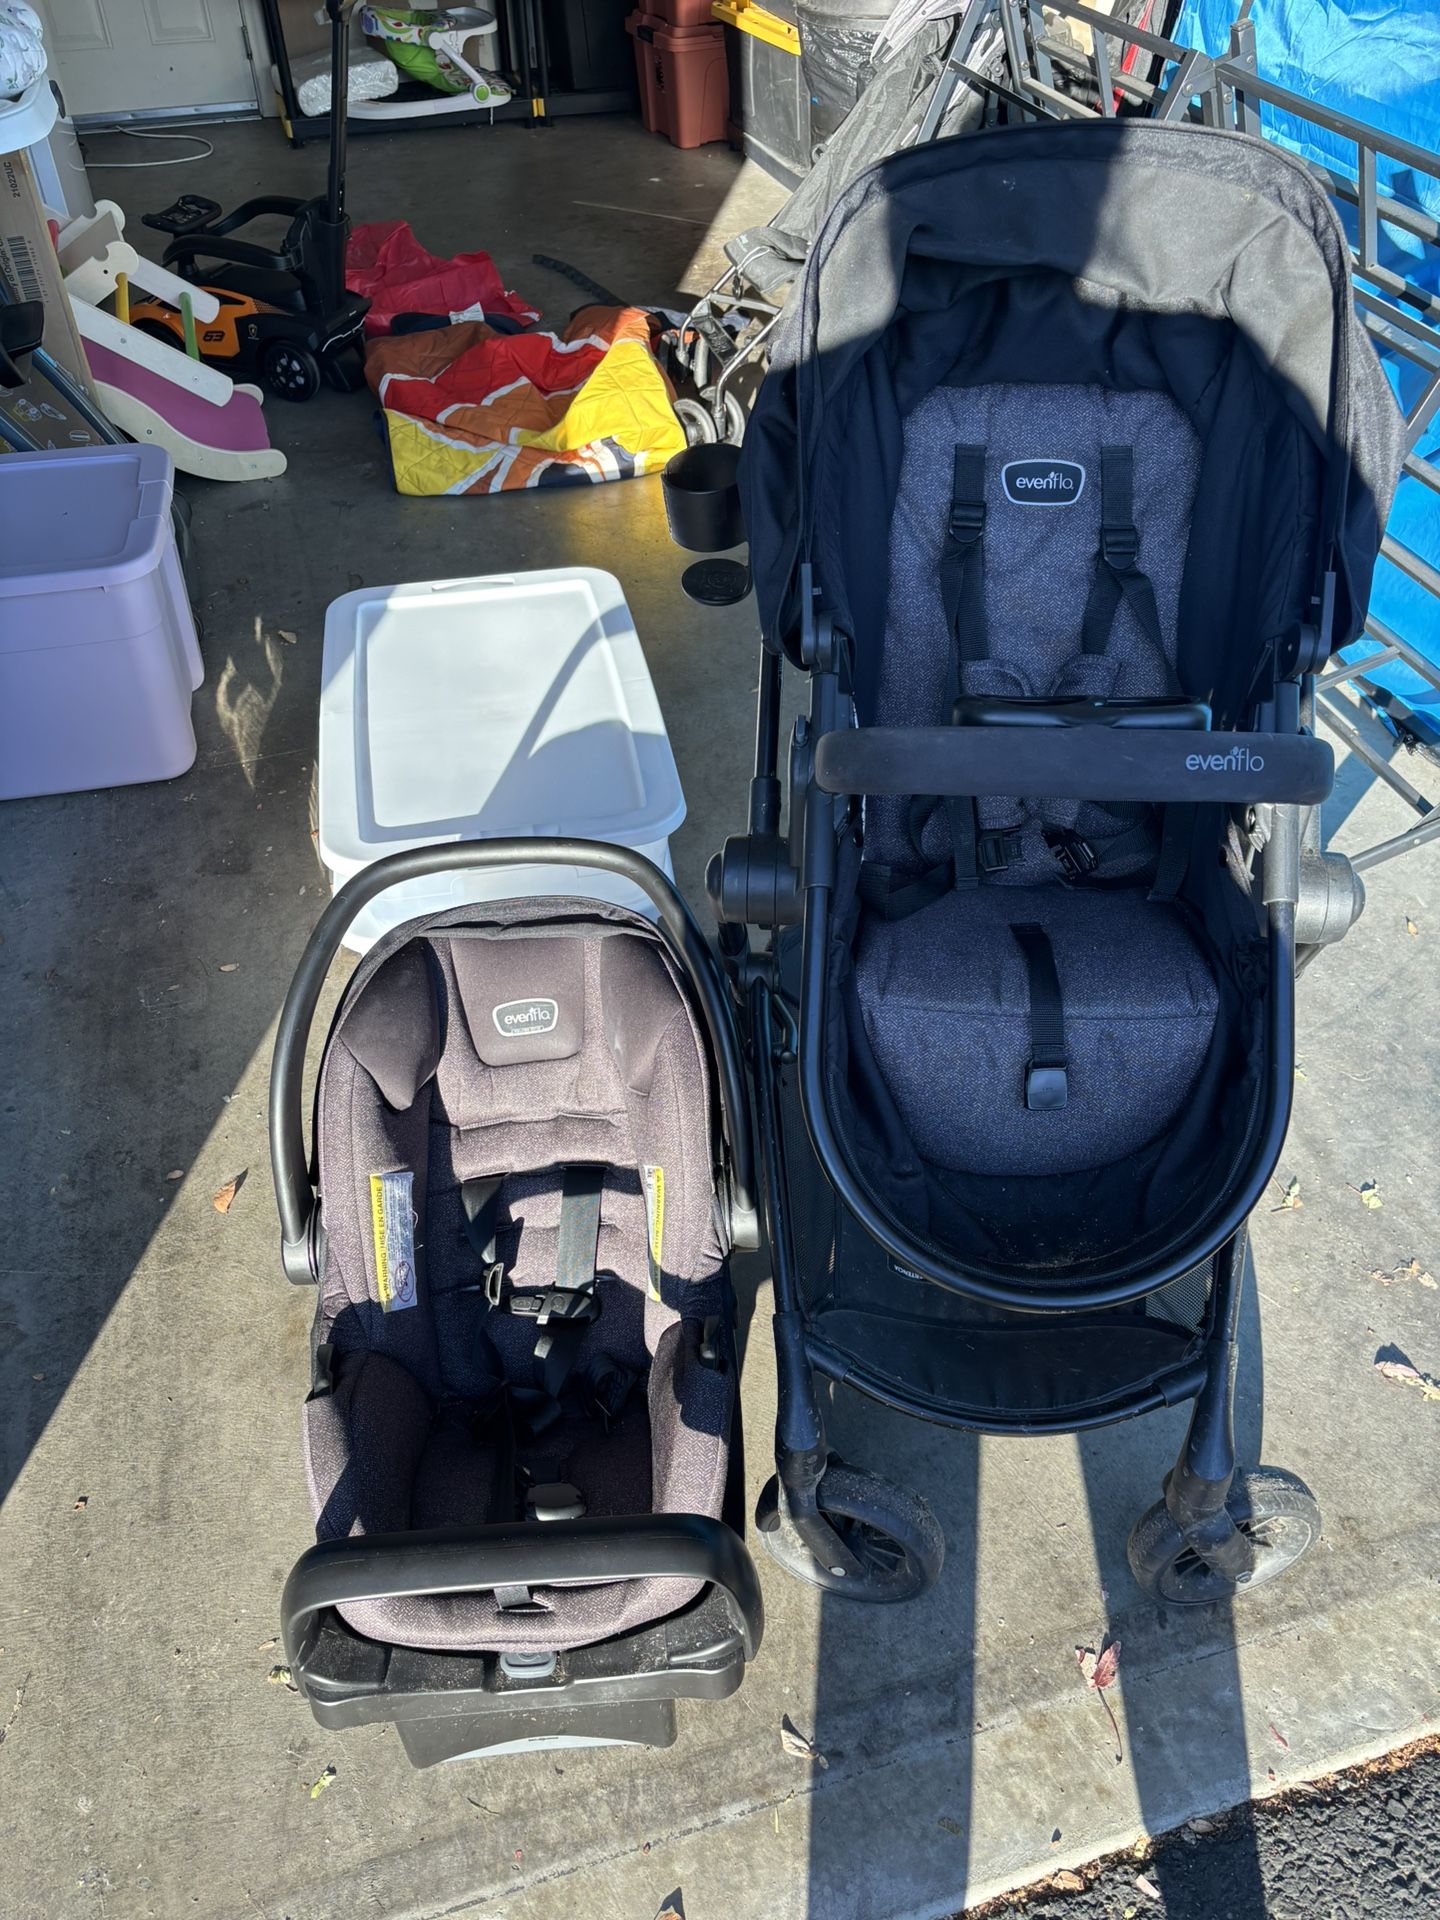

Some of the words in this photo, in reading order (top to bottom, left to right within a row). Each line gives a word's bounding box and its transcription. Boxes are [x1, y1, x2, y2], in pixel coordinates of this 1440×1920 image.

[4, 161, 21, 198] 21022UC
[1016, 472, 1073, 490] evenflo
[1185, 746, 1265, 772] evenflo
[504, 1007, 550, 1024] evenflo
